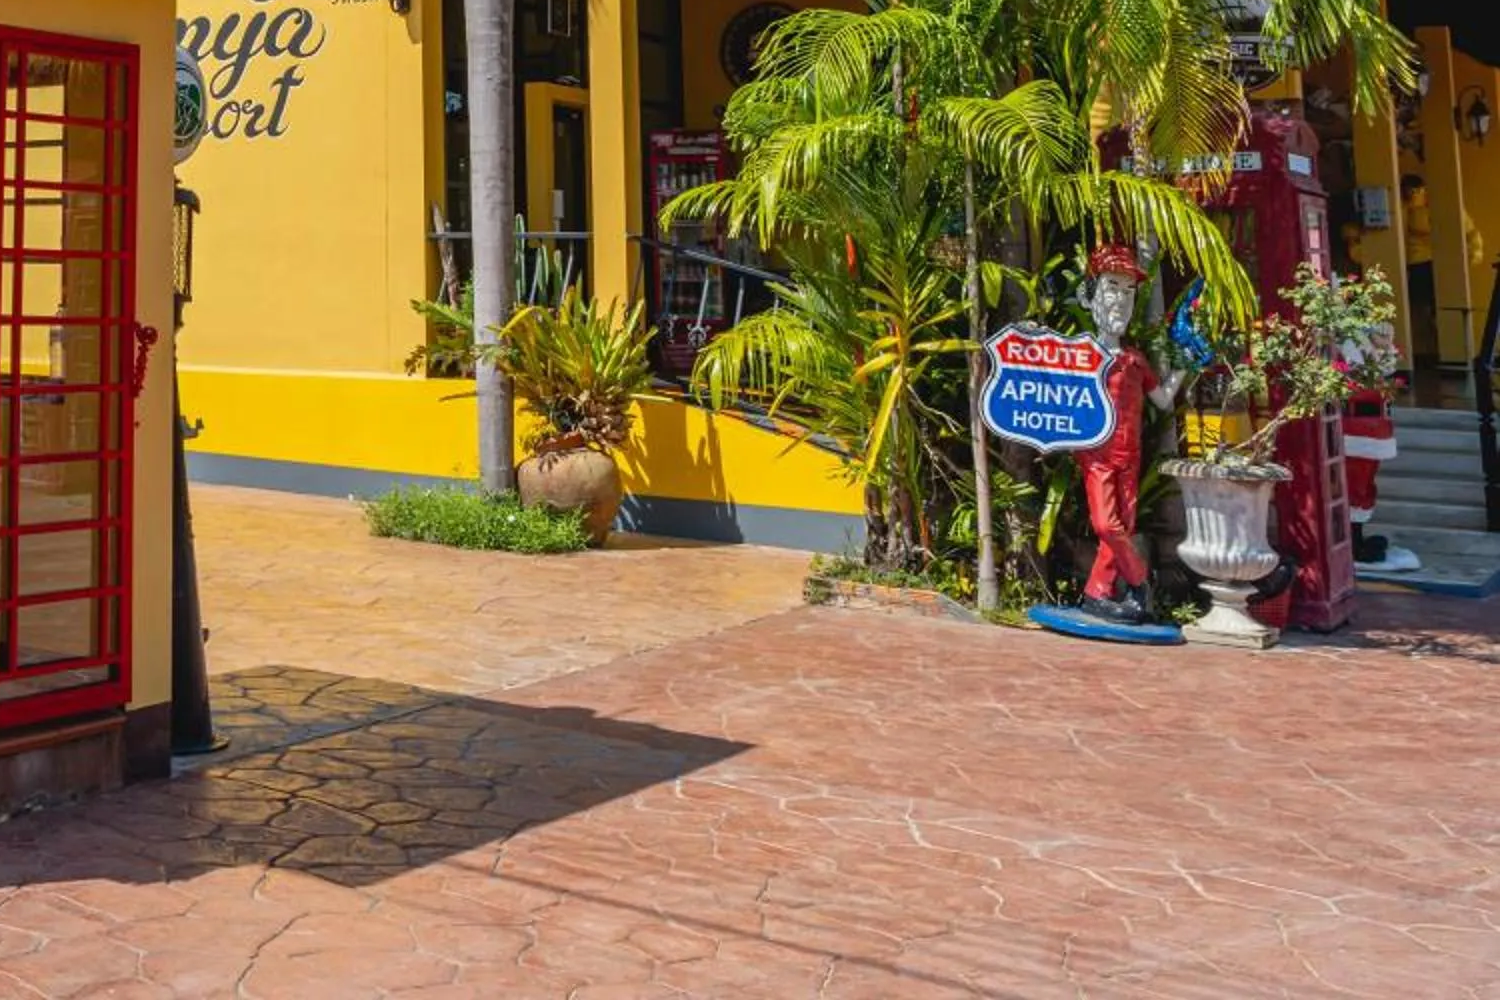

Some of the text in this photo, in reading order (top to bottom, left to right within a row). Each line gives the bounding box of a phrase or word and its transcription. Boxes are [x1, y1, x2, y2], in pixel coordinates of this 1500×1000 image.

[201, 65, 305, 138] ort
[1007, 341, 1092, 368] ROUTE
[1001, 379, 1095, 409] APINYA
[1012, 410, 1082, 435] HOTEL
